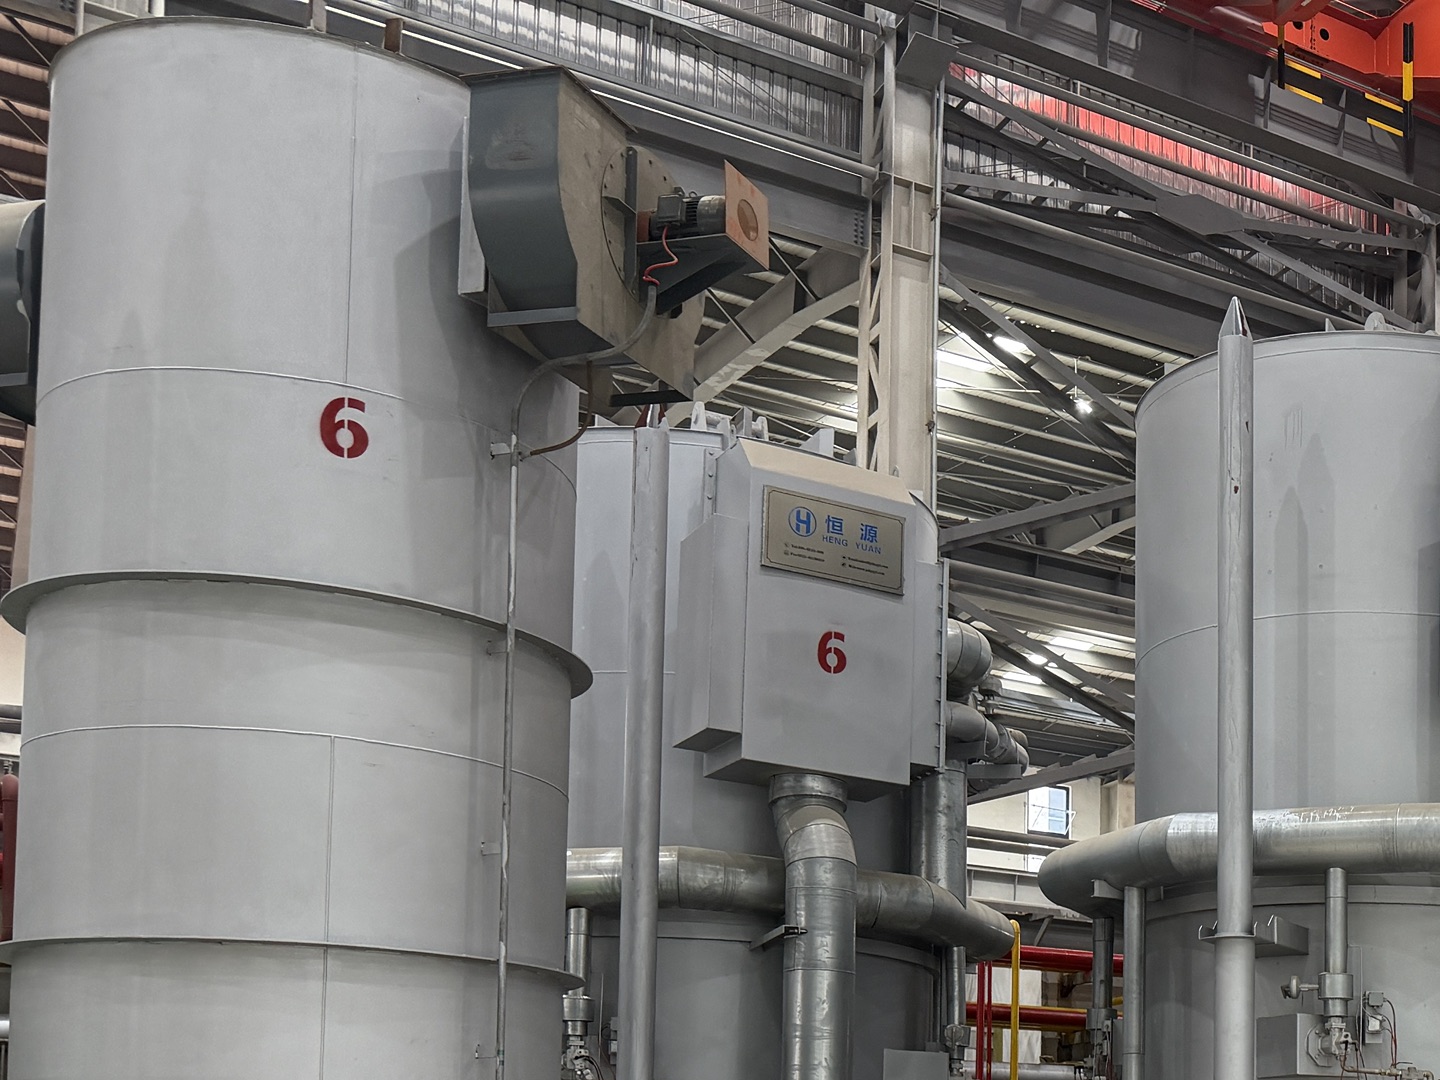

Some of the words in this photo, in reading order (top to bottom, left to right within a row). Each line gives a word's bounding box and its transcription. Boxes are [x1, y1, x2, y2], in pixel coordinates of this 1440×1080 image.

[320, 397, 369, 458] 6
[822, 535, 848, 547] HENG
[855, 542, 881, 554] YUAN
[825, 515, 878, 543] 恒源
[818, 631, 847, 674] 6
